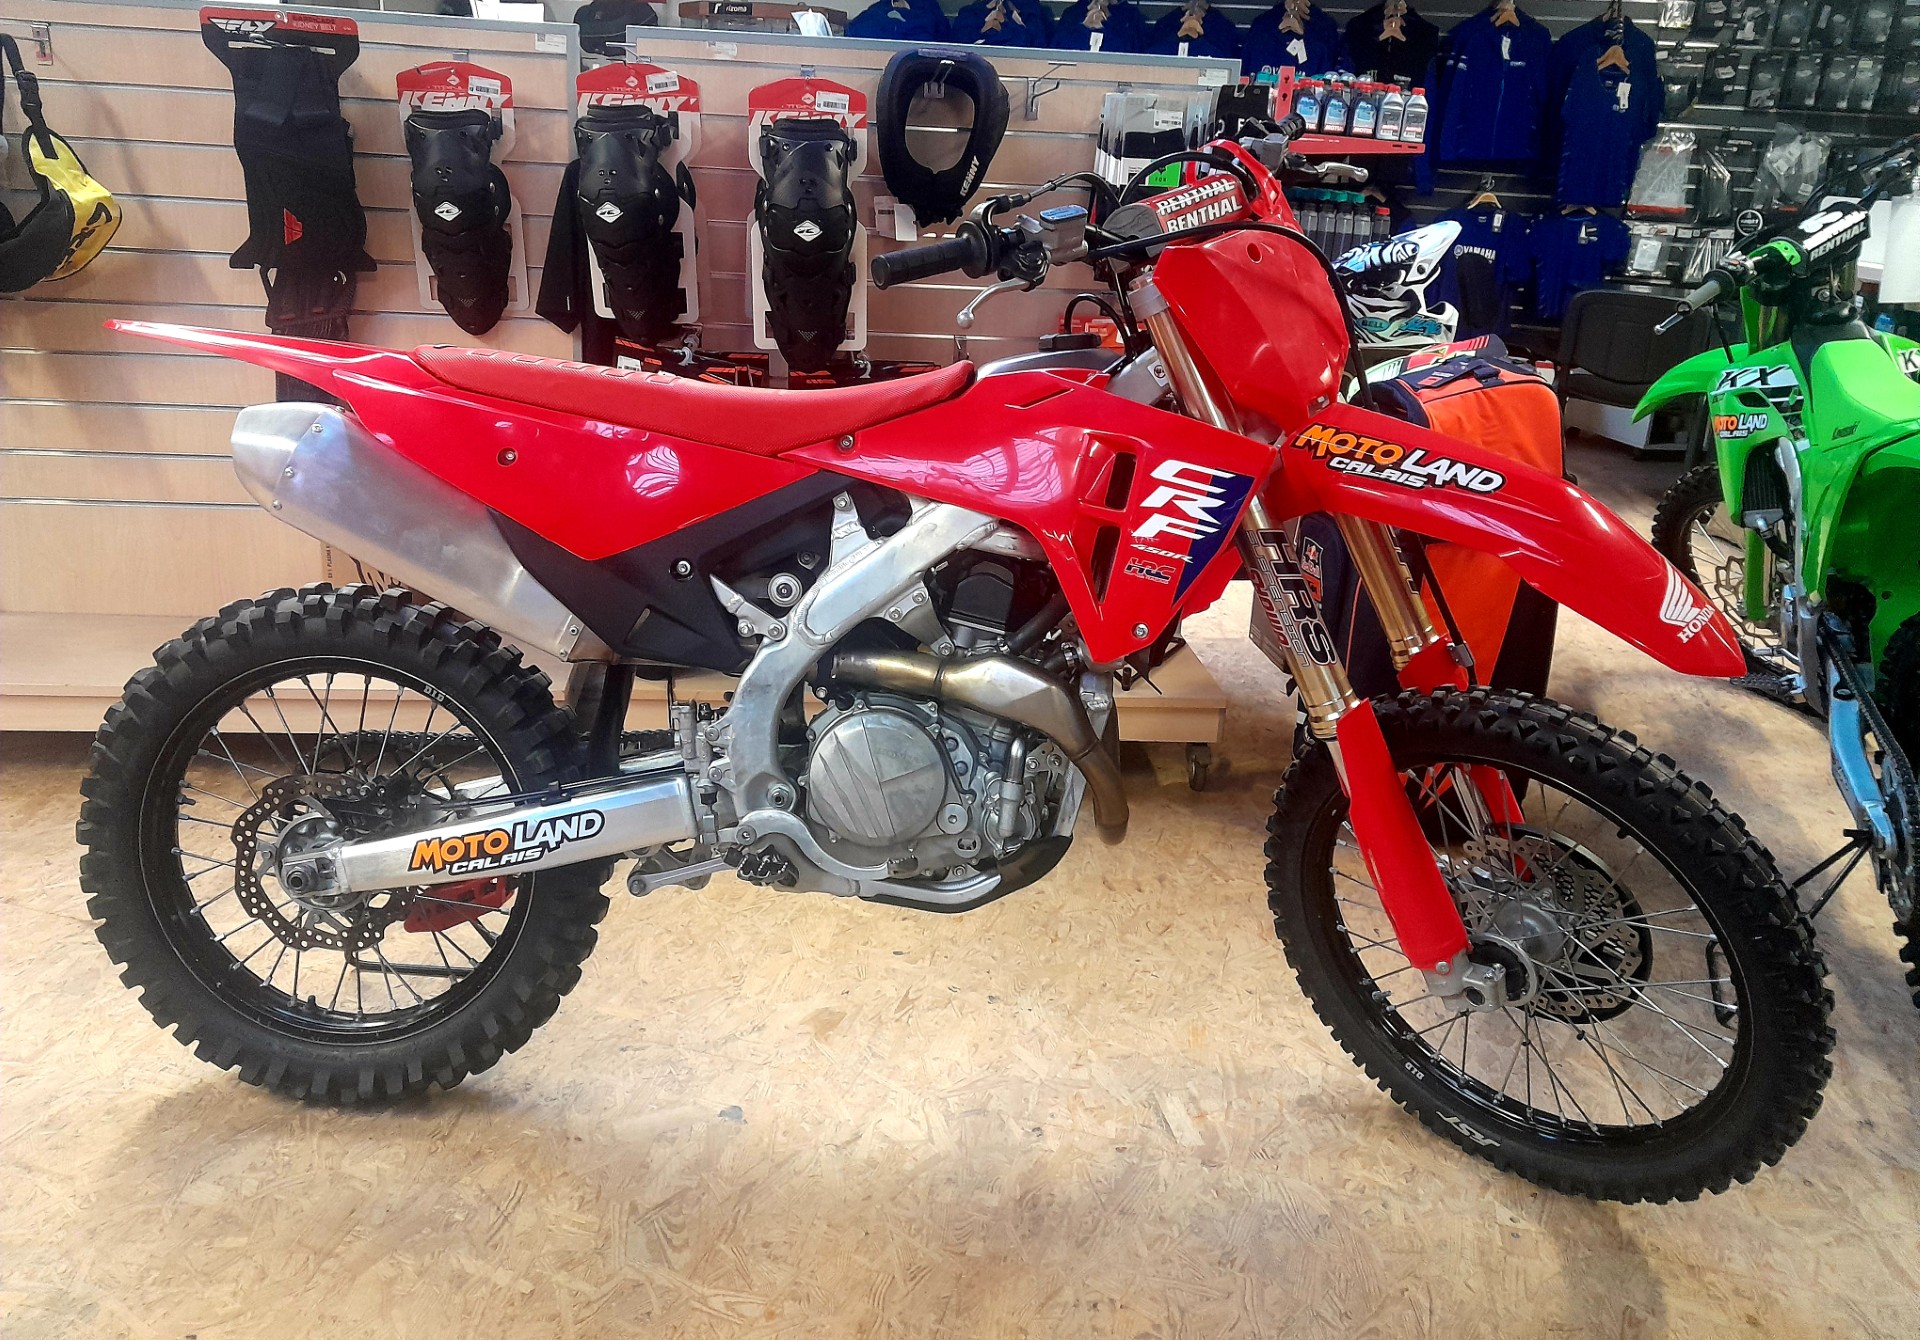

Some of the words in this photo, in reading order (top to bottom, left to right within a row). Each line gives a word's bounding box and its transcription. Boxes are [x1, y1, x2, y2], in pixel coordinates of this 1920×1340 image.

[399, 90, 511, 111] KENNY
[960, 155, 980, 196] KENNY
[1166, 195, 1243, 233] RENTHAL
[1463, 245, 1496, 261] YAMAHA
[1809, 221, 1868, 262] RENTHAL
[1738, 414, 1767, 431] LAND
[1296, 424, 1404, 466] MOTO
[1401, 448, 1503, 492] LAND
[1328, 456, 1427, 489] CALAIS
[1131, 459, 1237, 540] CRF
[1124, 556, 1177, 581] HRC
[1257, 529, 1337, 666] HRS
[1676, 604, 1716, 644] HONDA
[412, 830, 510, 871] MOTO
[514, 812, 603, 851] LAND
[451, 849, 543, 874] CALAIS
